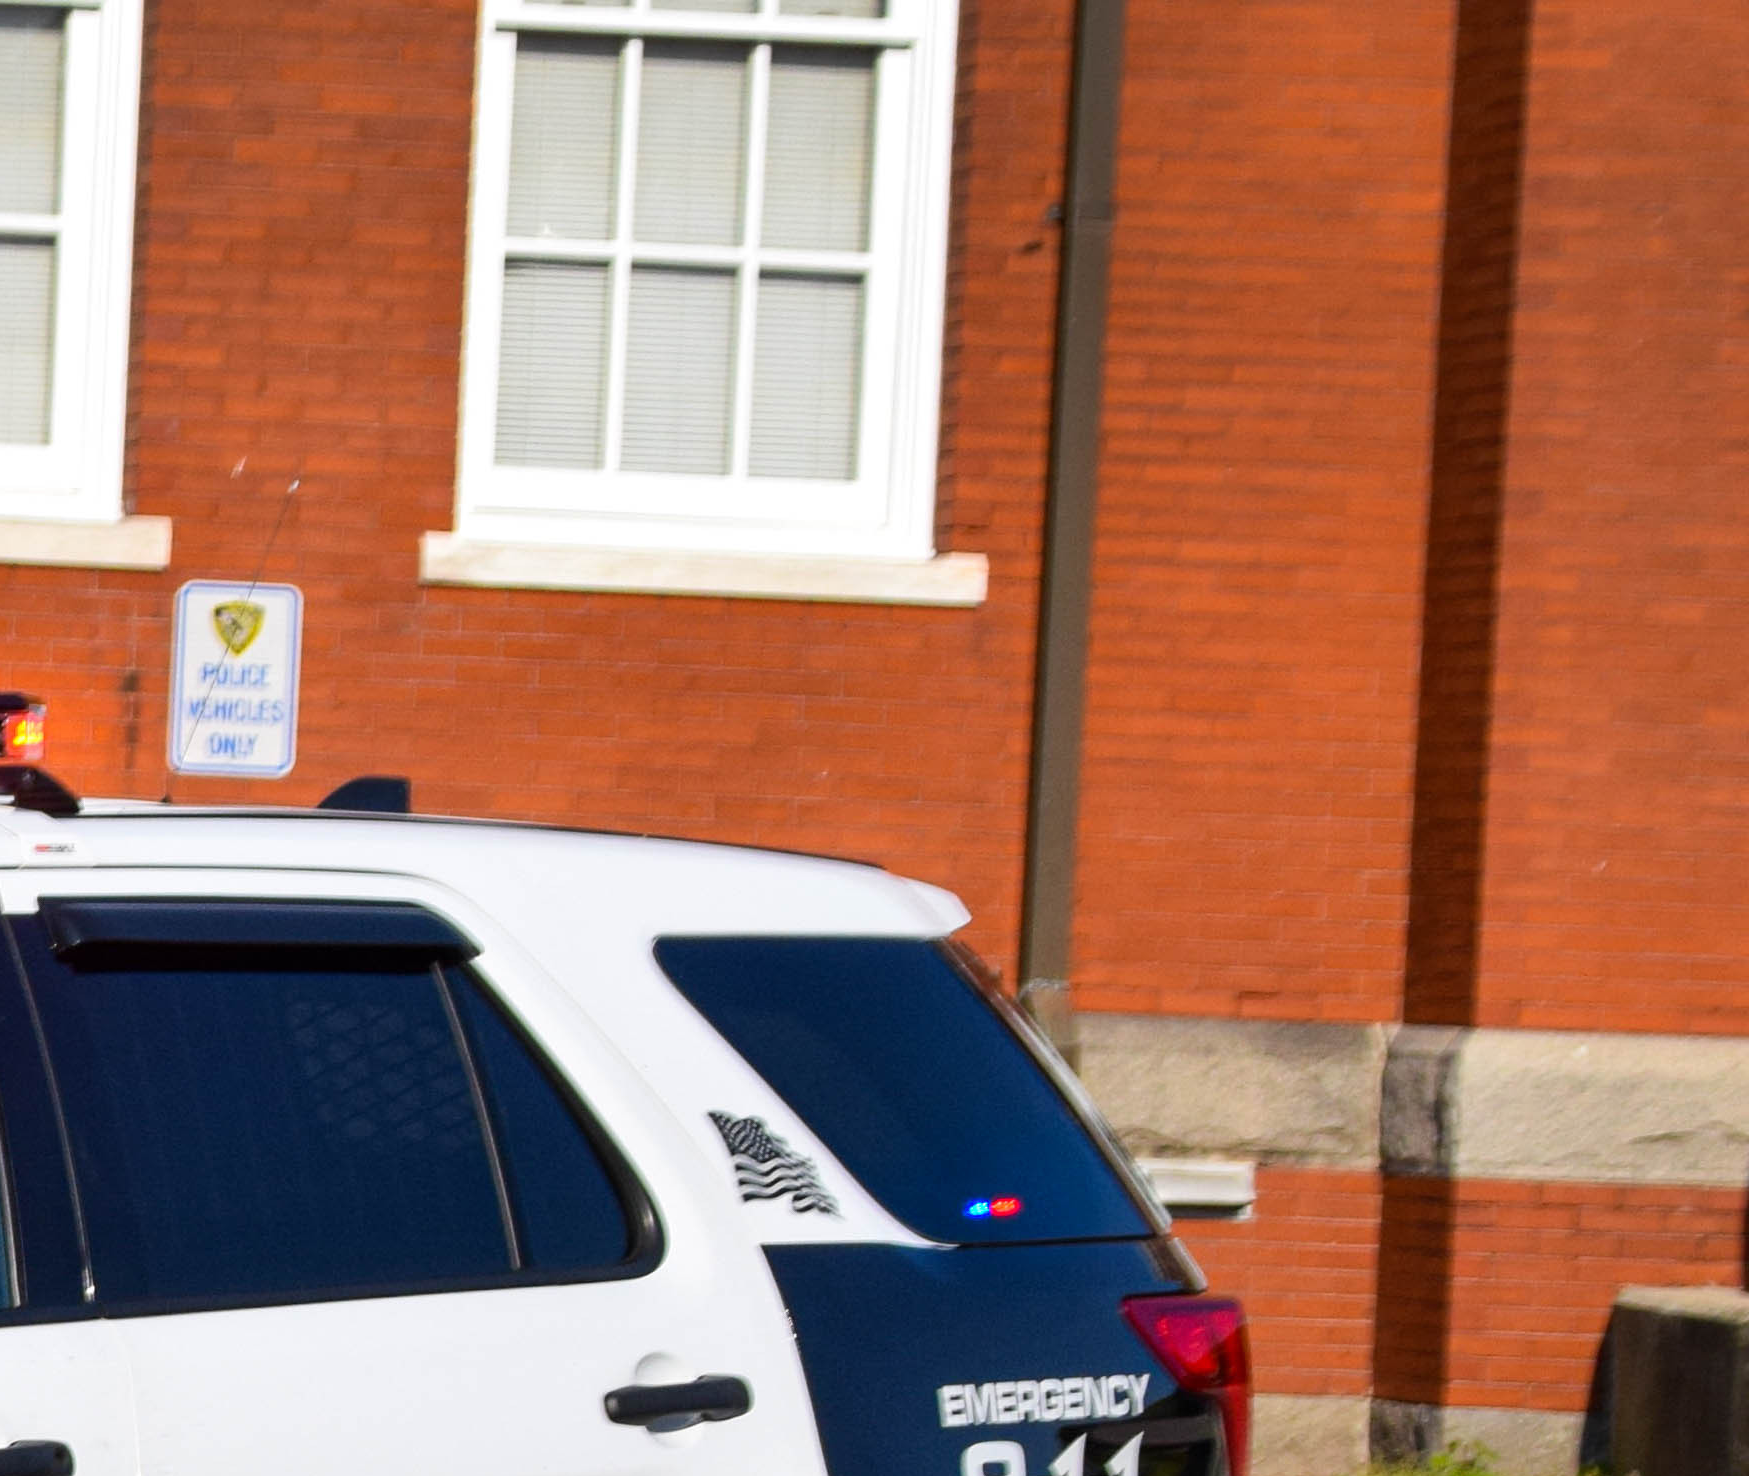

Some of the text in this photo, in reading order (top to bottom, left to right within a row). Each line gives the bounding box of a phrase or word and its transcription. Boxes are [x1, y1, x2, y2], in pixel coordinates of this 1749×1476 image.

[201, 663, 271, 687] POLICE
[189, 697, 284, 723] VEHICLES
[208, 732, 259, 757] ONLY
[936, 1373, 1150, 1428] EMERGENCY
